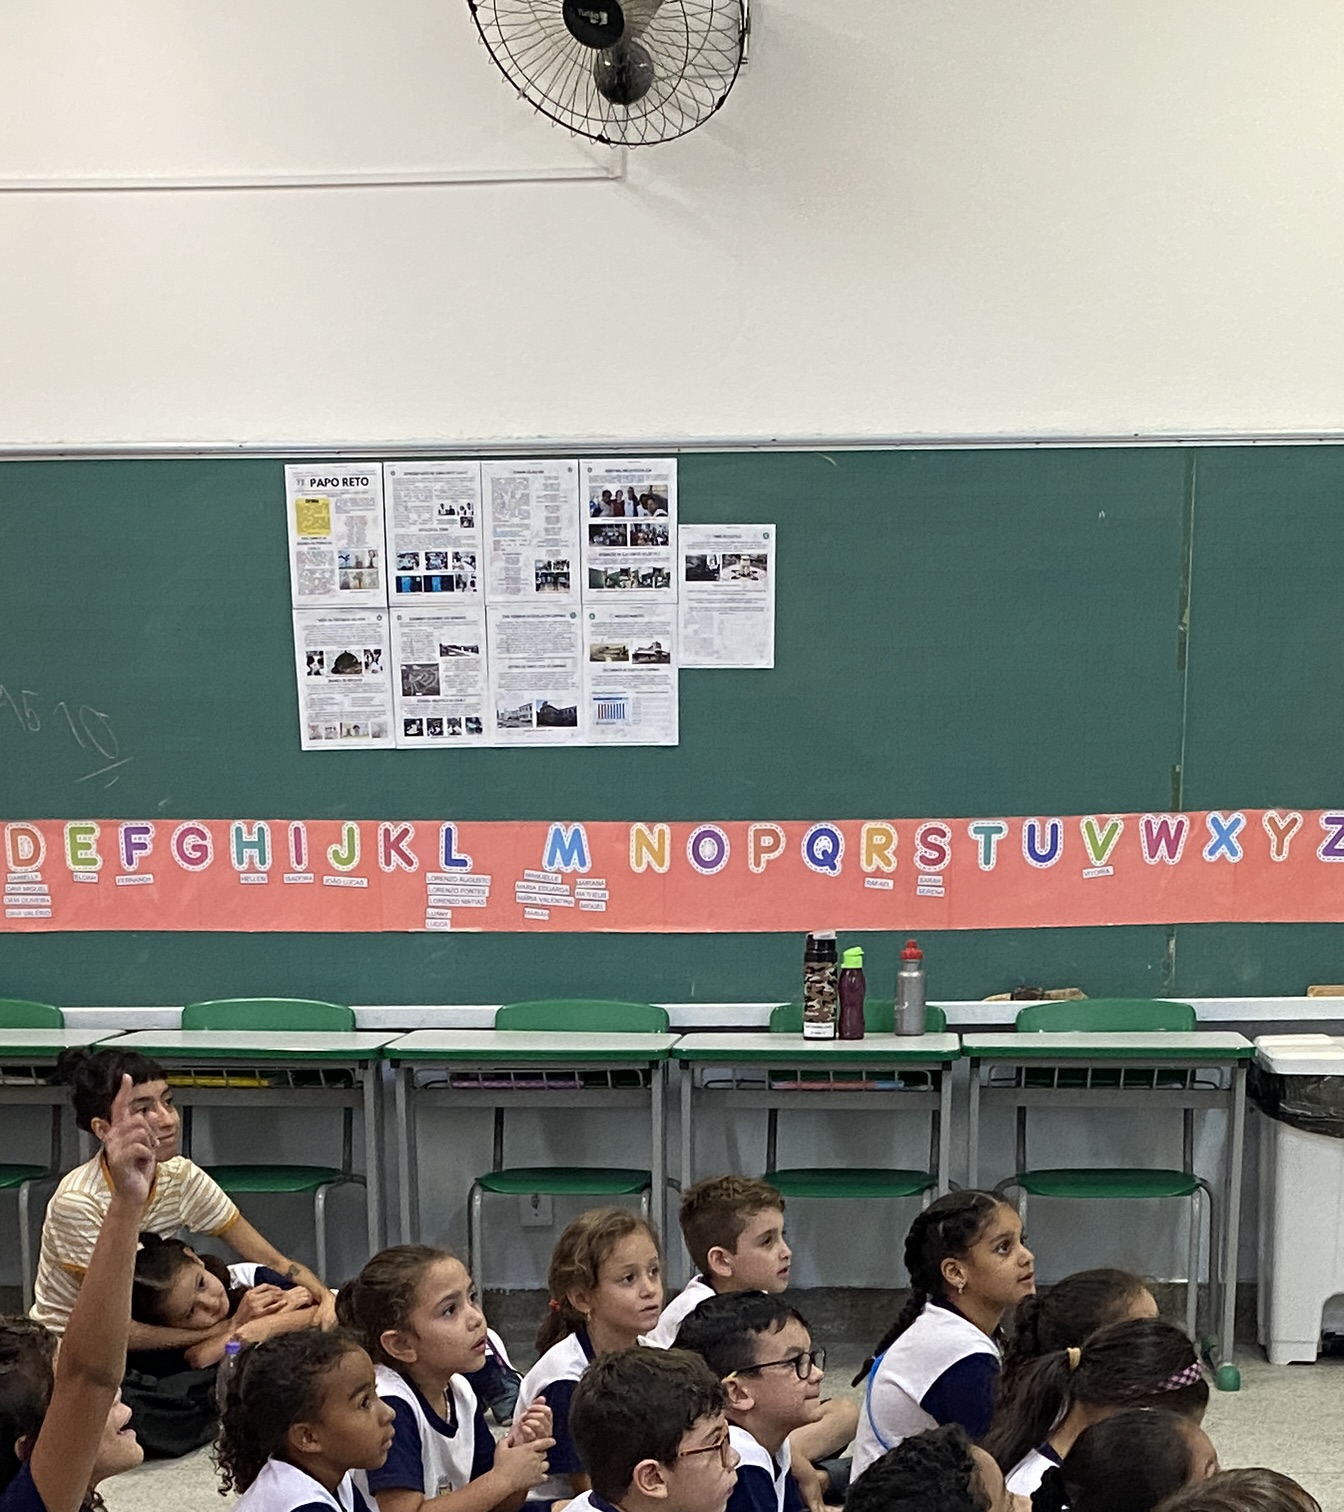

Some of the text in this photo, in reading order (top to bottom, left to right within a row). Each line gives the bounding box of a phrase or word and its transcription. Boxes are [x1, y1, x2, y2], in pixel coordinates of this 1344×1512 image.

[310, 477, 369, 488] PAPO RETO
[7, 824, 44, 870] D
[66, 824, 100, 869] E
[121, 824, 153, 868] F
[174, 824, 211, 869] G
[233, 824, 268, 869] H
[290, 824, 306, 869] I
[330, 824, 358, 869] J
[380, 824, 416, 870] K
[442, 824, 470, 869] L
[544, 824, 589, 870] M
[632, 825, 668, 870] N
[690, 826, 728, 872] O
[750, 825, 783, 870] P
[804, 825, 842, 874] Q
[862, 824, 895, 870] R
[916, 824, 948, 870] S
[971, 823, 1005, 868] T
[1025, 820, 1061, 866] U
[1083, 818, 1121, 864] V
[1142, 816, 1187, 862] W
[1205, 814, 1243, 860] X
[1265, 814, 1300, 859] Y
